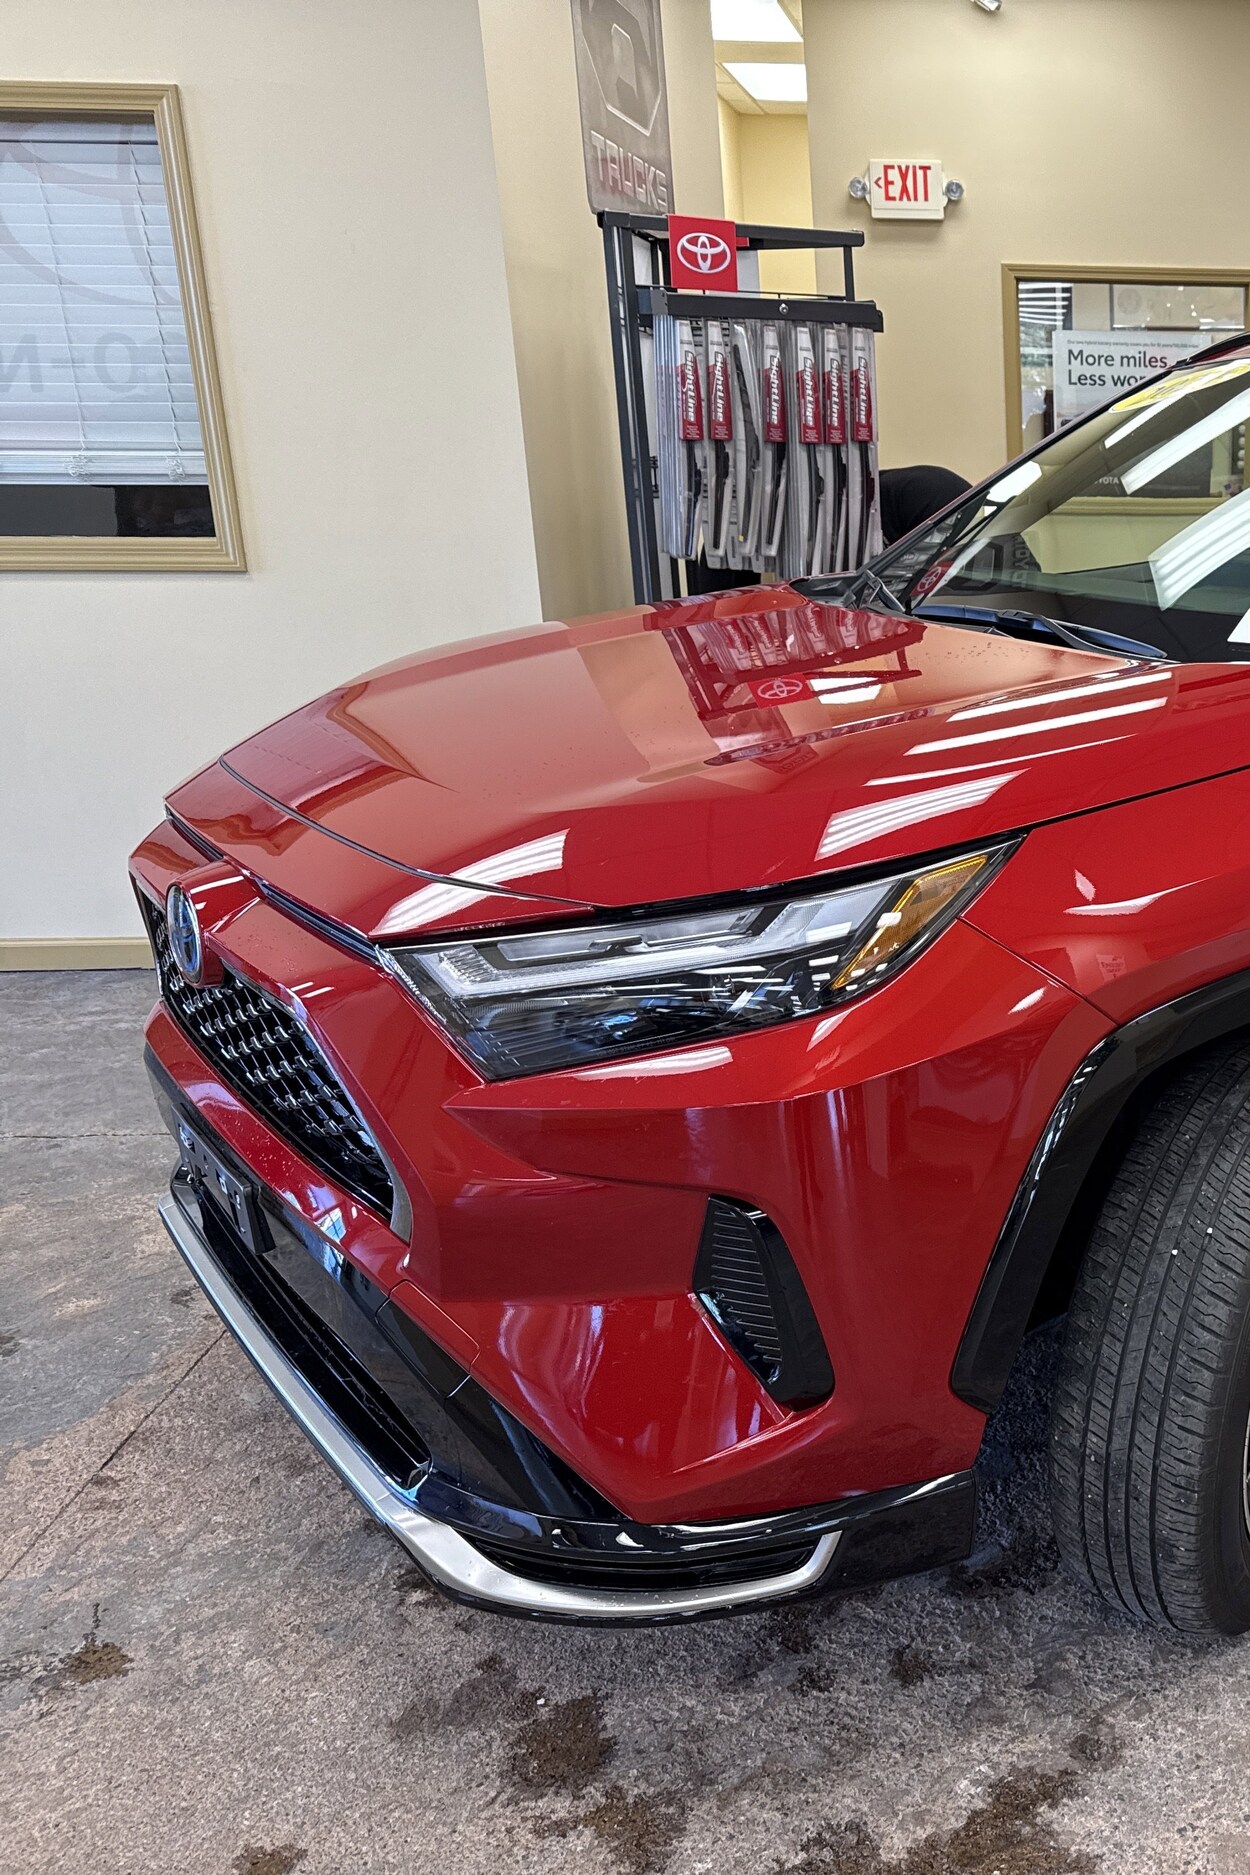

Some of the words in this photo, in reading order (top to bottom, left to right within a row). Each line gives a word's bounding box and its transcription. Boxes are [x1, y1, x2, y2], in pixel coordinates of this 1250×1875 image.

[590, 130, 668, 211] TRUCKS
[883, 164, 932, 202] EXIT
[1068, 349, 1114, 367] More
[1068, 369, 1106, 387] Less
[1111, 375, 1146, 387] wor
